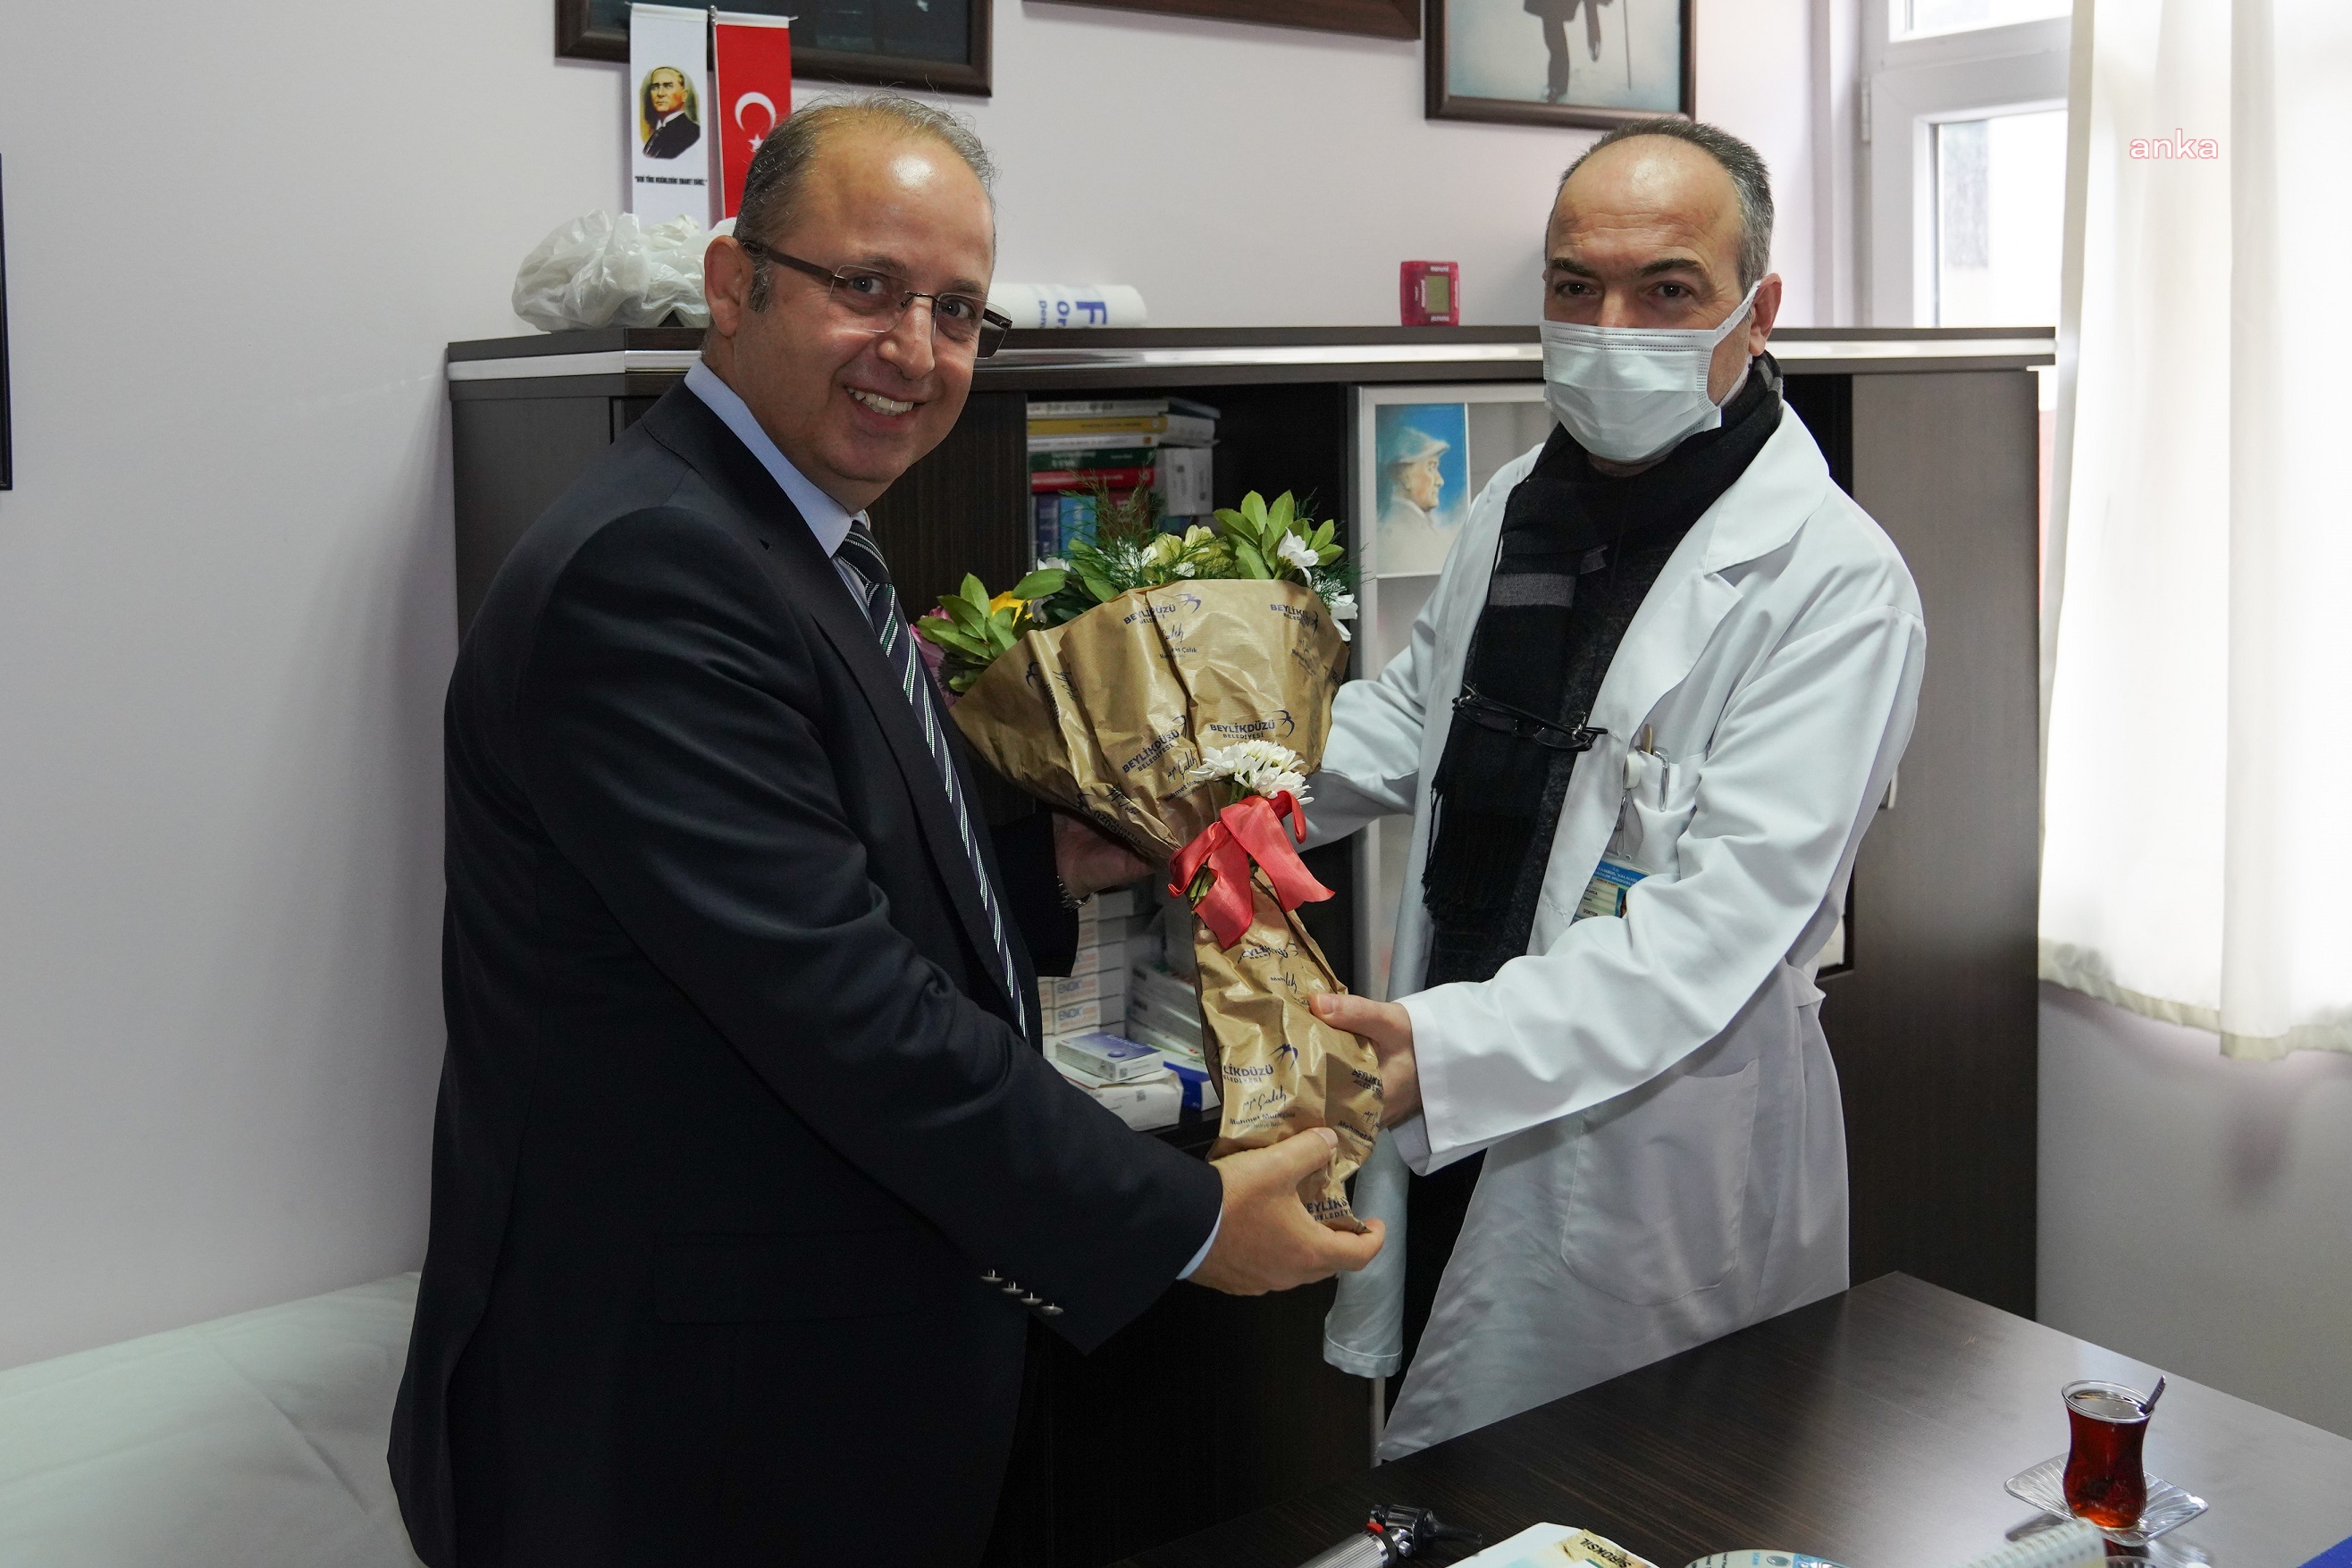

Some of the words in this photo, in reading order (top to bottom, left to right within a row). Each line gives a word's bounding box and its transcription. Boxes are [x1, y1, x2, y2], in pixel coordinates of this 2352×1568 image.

[1209, 719, 1276, 733] BEYLİKDÜZÜ
[1222, 732, 1264, 740] BELEDİYESİ
[1121, 729, 1180, 774] BEYLİKDÜZÜ
